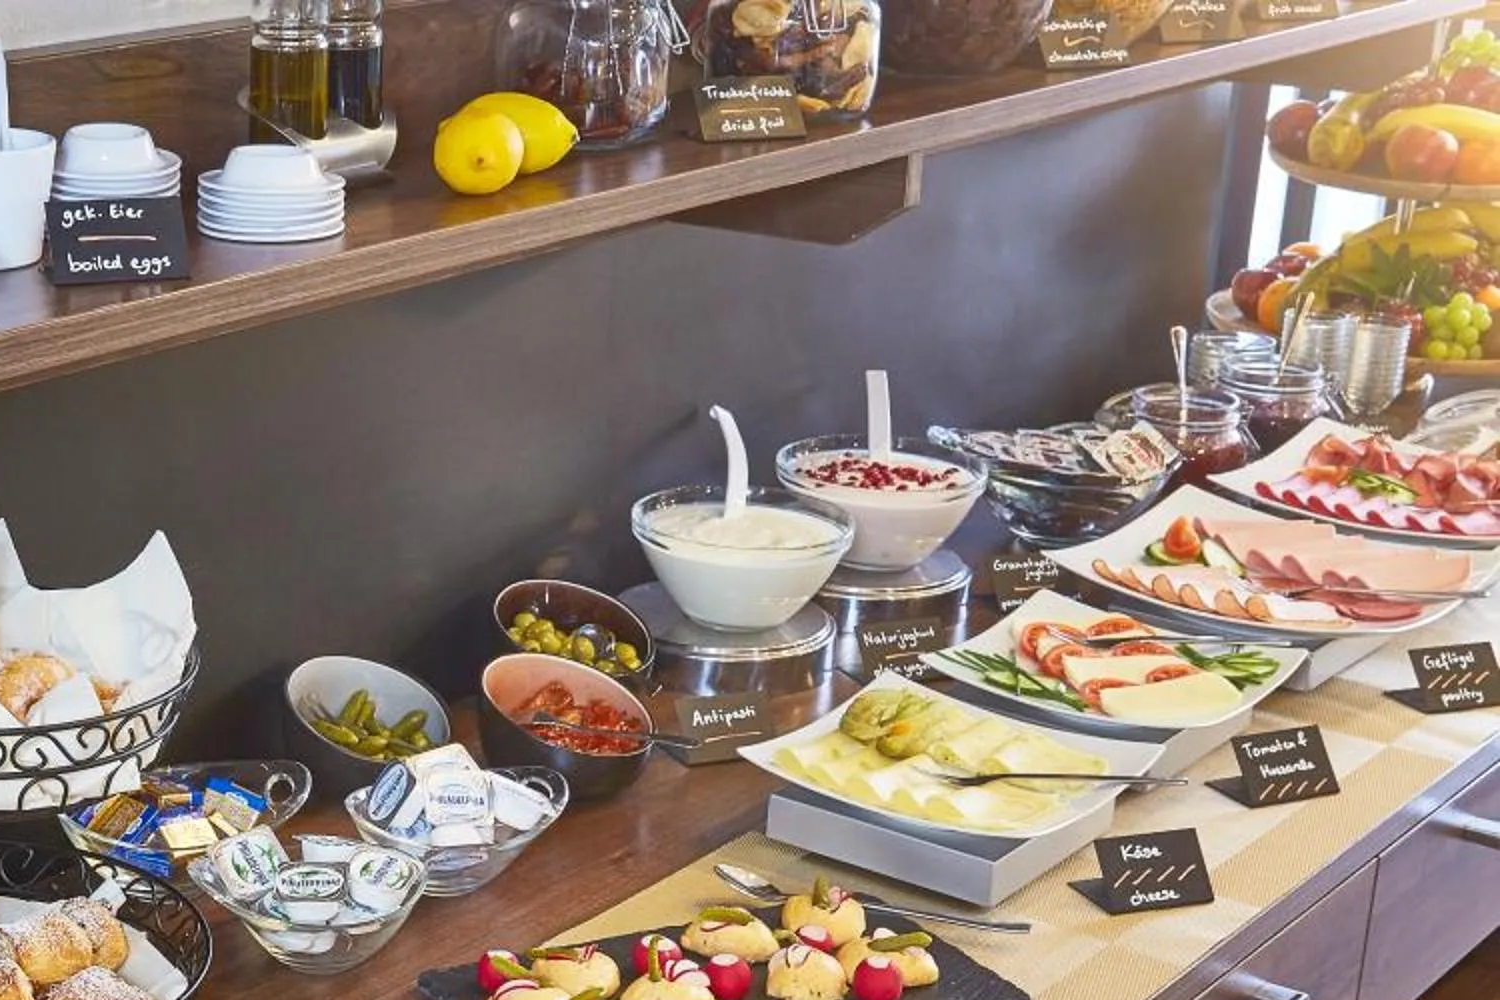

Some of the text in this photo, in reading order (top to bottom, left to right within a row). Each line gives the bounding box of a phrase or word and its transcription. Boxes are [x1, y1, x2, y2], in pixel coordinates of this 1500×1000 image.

[721, 116, 785, 135] dried fruit
[61, 203, 144, 228] gek. Eier
[67, 252, 171, 275] boiled eggs
[692, 705, 757, 727] Antipasti
[1241, 738, 1297, 760] Tomaten
[1120, 844, 1163, 861] Käse
[1130, 889, 1181, 906] cheese
